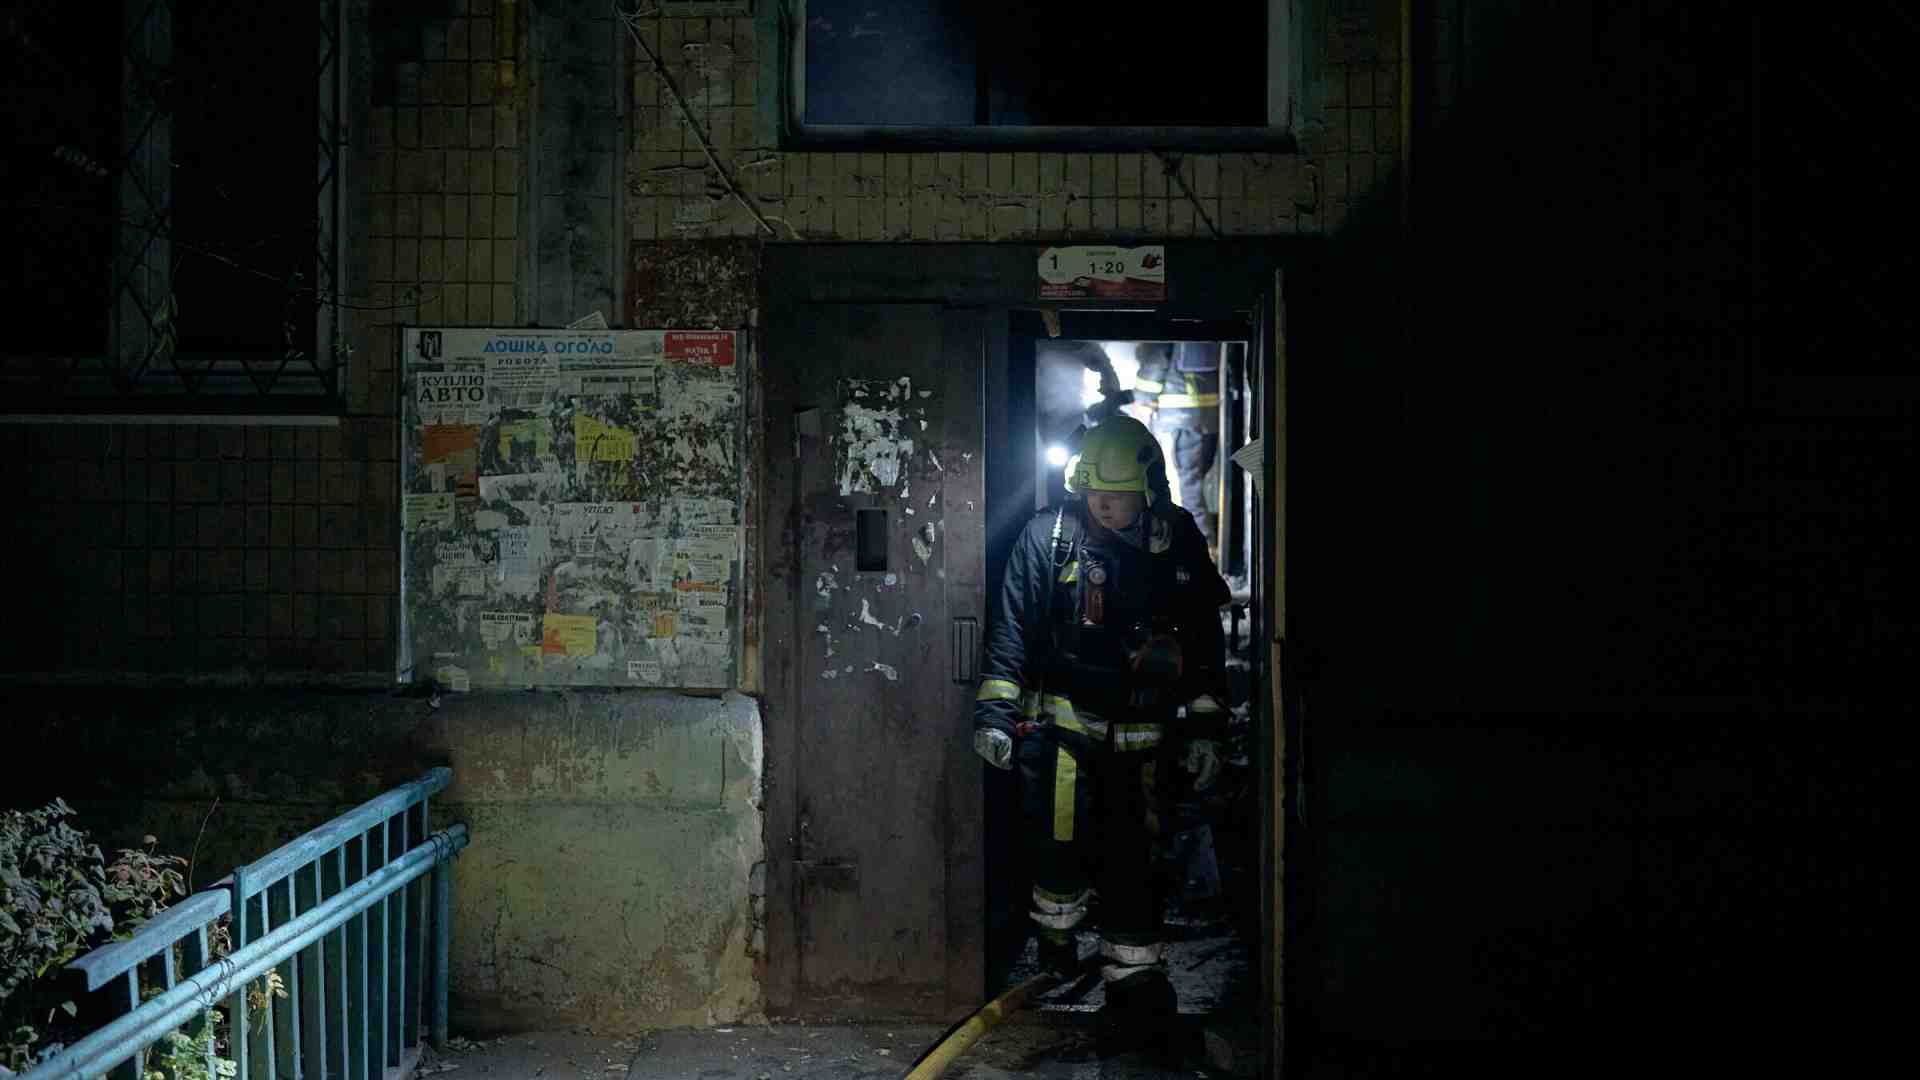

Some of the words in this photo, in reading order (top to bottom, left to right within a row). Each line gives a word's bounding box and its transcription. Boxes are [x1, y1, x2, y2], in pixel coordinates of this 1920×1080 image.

[1049, 254, 1058, 270] 1
[1089, 262, 1125, 274] 1-20
[421, 375, 485, 386] КУПЛЮ
[418, 386, 485, 402] АВТО
